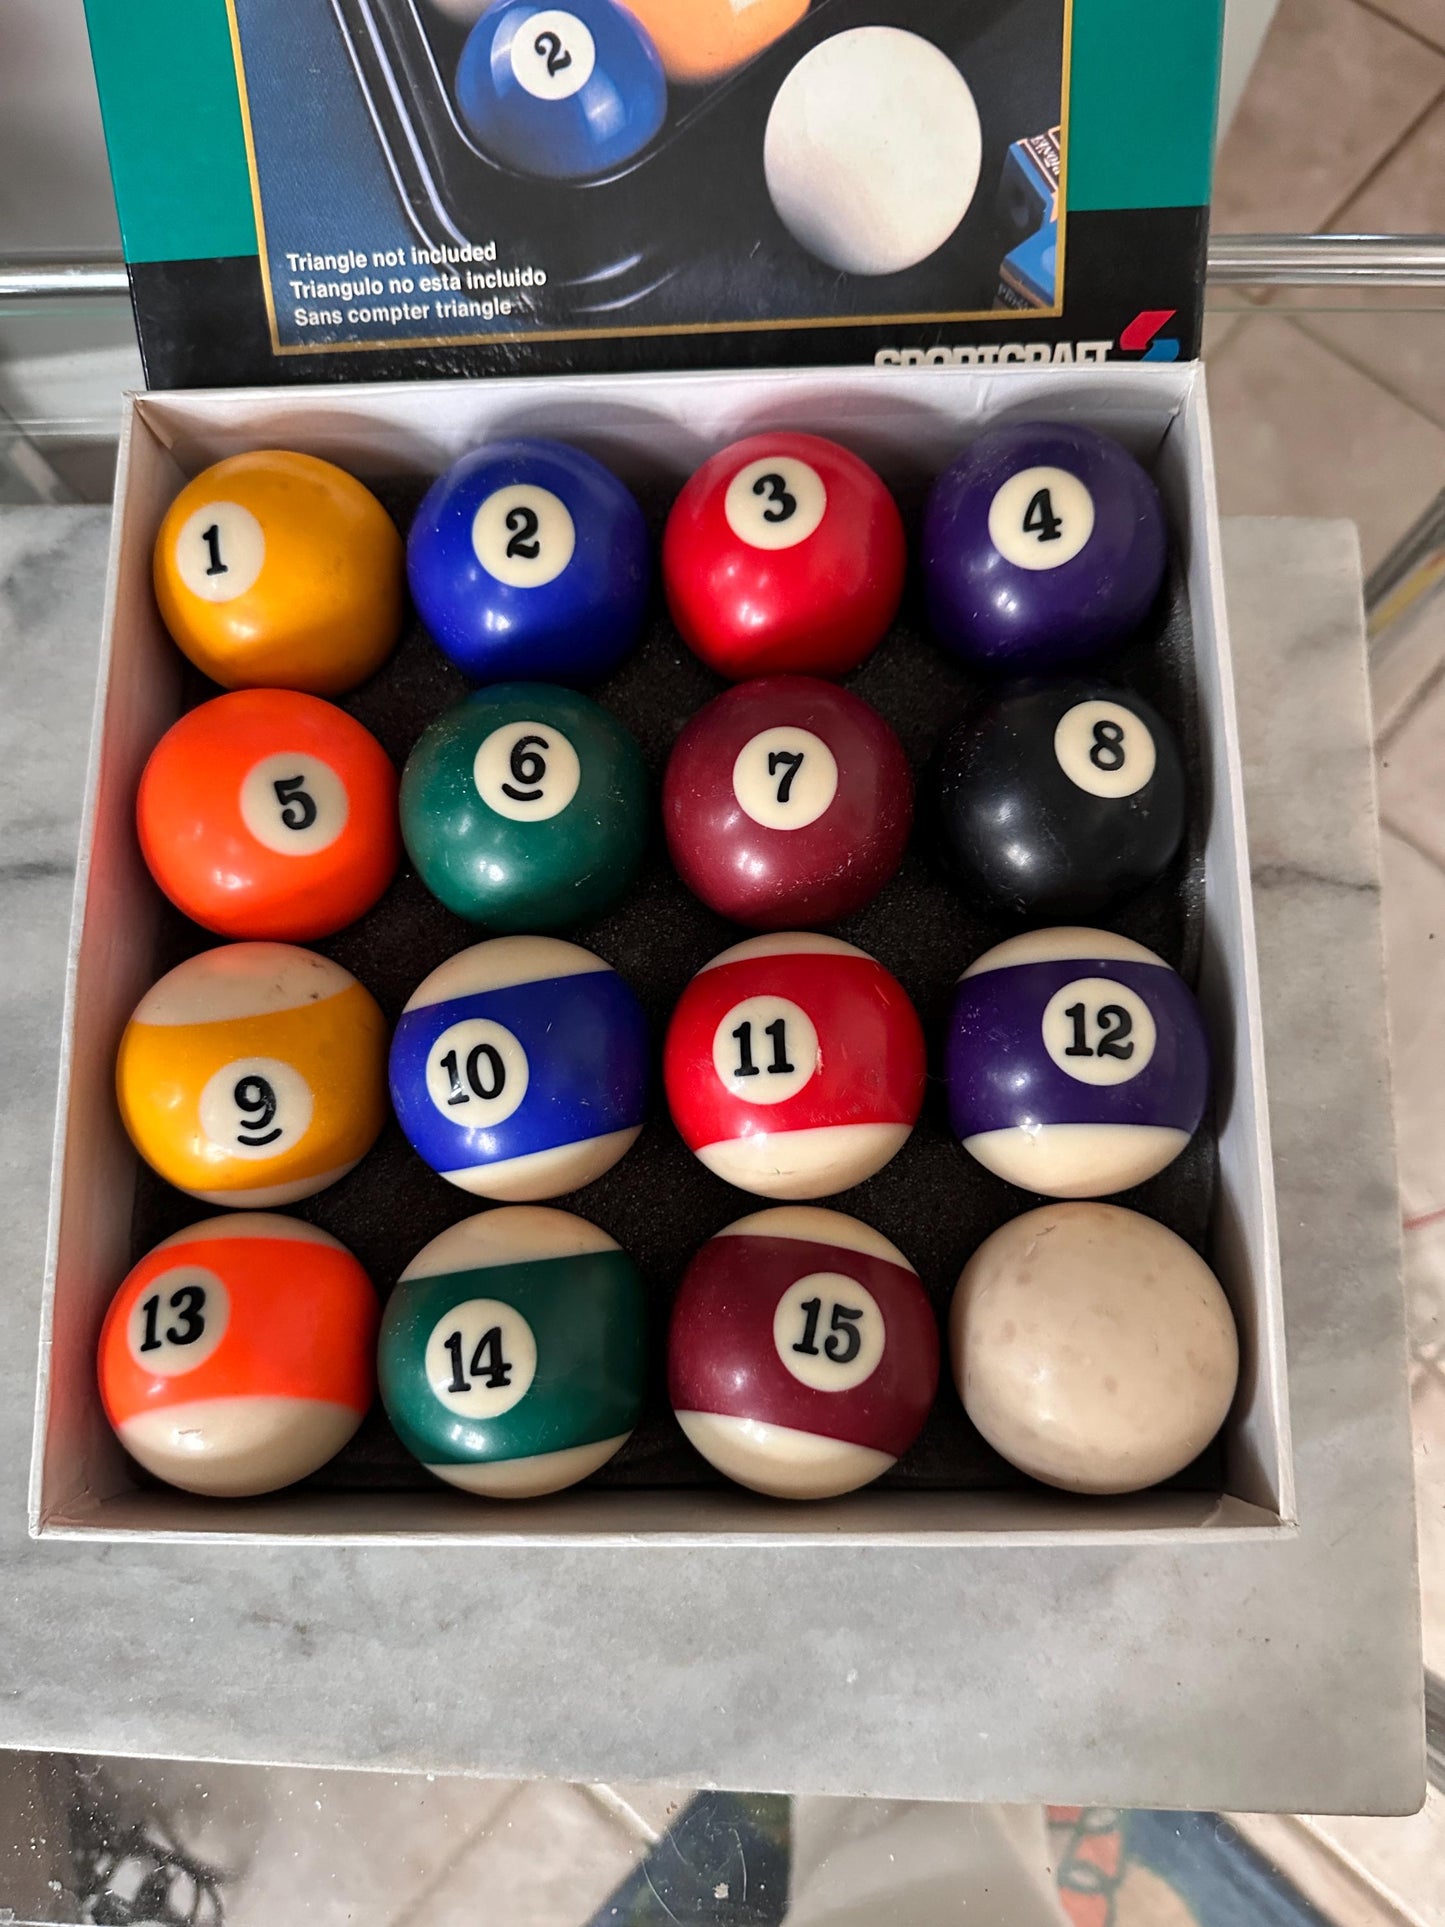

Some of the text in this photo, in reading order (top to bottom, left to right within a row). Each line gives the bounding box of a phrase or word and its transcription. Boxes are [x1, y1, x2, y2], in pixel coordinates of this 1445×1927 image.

[534, 31, 572, 77] 2
[286, 240, 497, 274] Triangle not included
[289, 267, 547, 300] Triangulo no esta incluido
[294, 297, 512, 327] Sans compter triangle
[752, 473, 797, 523] 3
[1022, 488, 1063, 542] 4
[202, 524, 229, 576] 1
[505, 507, 540, 559] 2
[509, 735, 549, 785] 6
[1090, 720, 1126, 772] 8
[273, 775, 317, 831] 5
[767, 751, 804, 803] 7
[732, 1018, 795, 1077] 11
[1064, 1001, 1135, 1061] 12
[440, 1043, 506, 1106] 10
[234, 1075, 277, 1130] 9
[140, 1286, 206, 1353] 13
[791, 1297, 864, 1363] 15
[444, 1326, 512, 1394] 14
